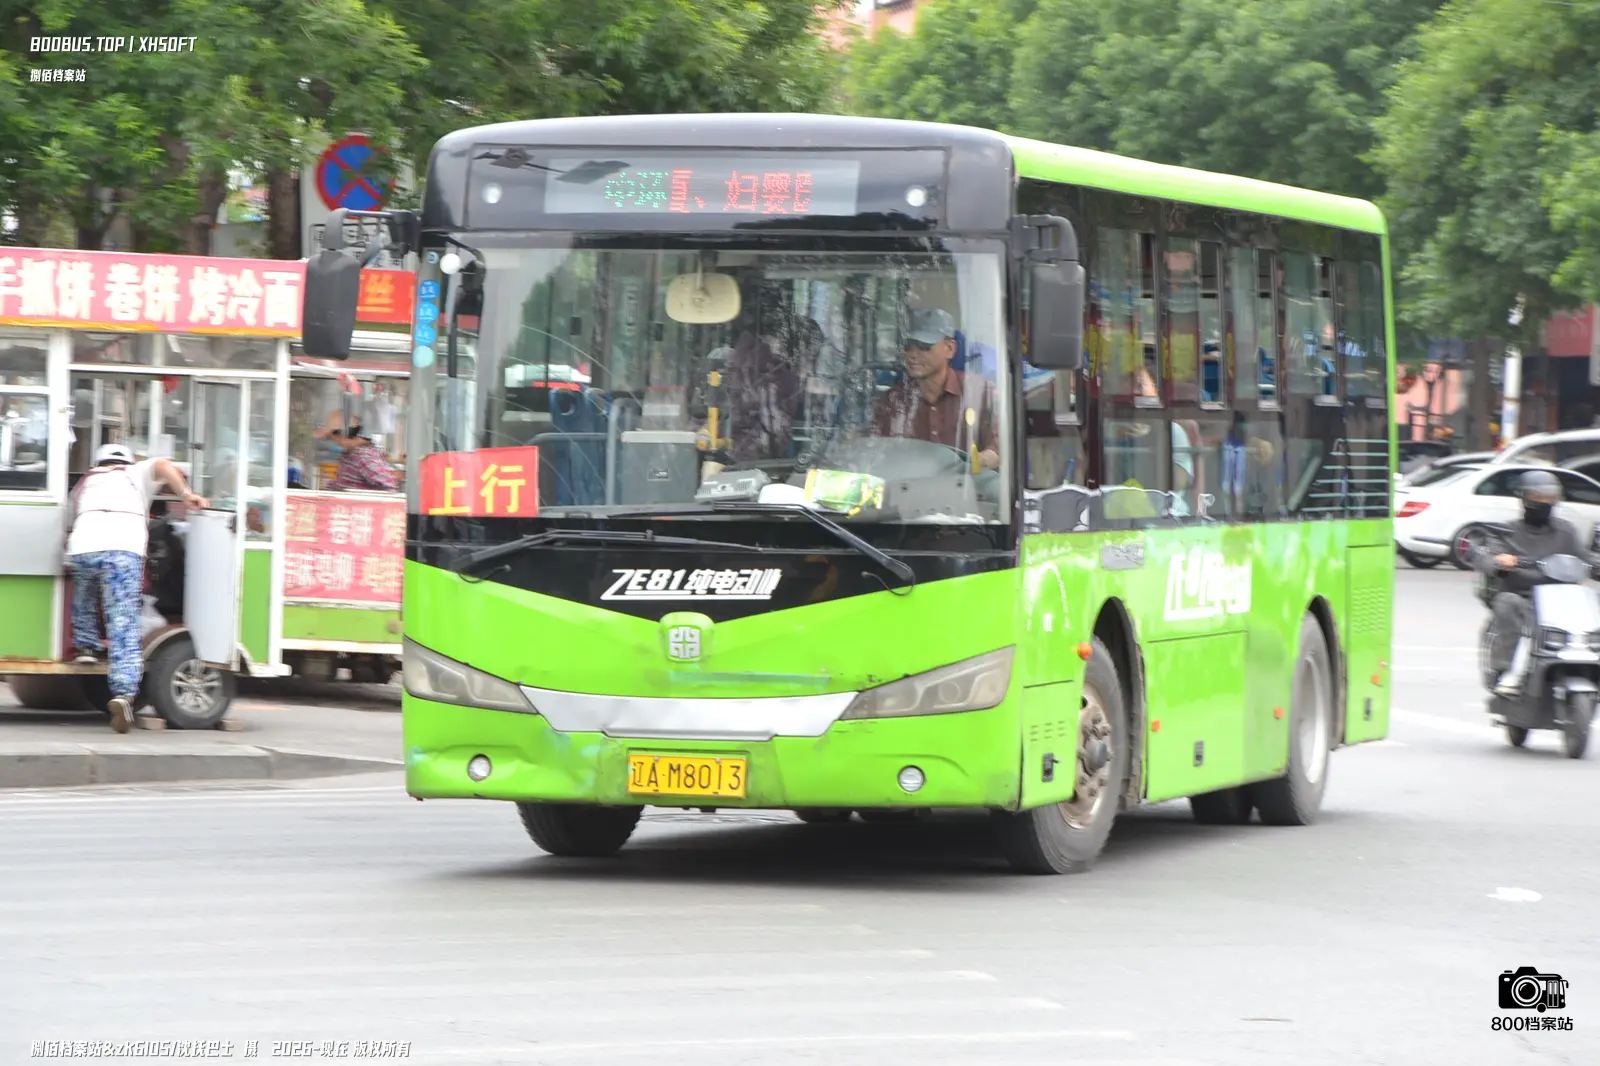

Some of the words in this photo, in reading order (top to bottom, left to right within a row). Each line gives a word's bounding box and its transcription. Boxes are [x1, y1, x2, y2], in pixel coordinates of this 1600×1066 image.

[104, 262, 181, 324] 卷饼
[188, 266, 302, 328] 烤冷面
[428, 462, 527, 516] 上行
[600, 569, 687, 599] ZE81
